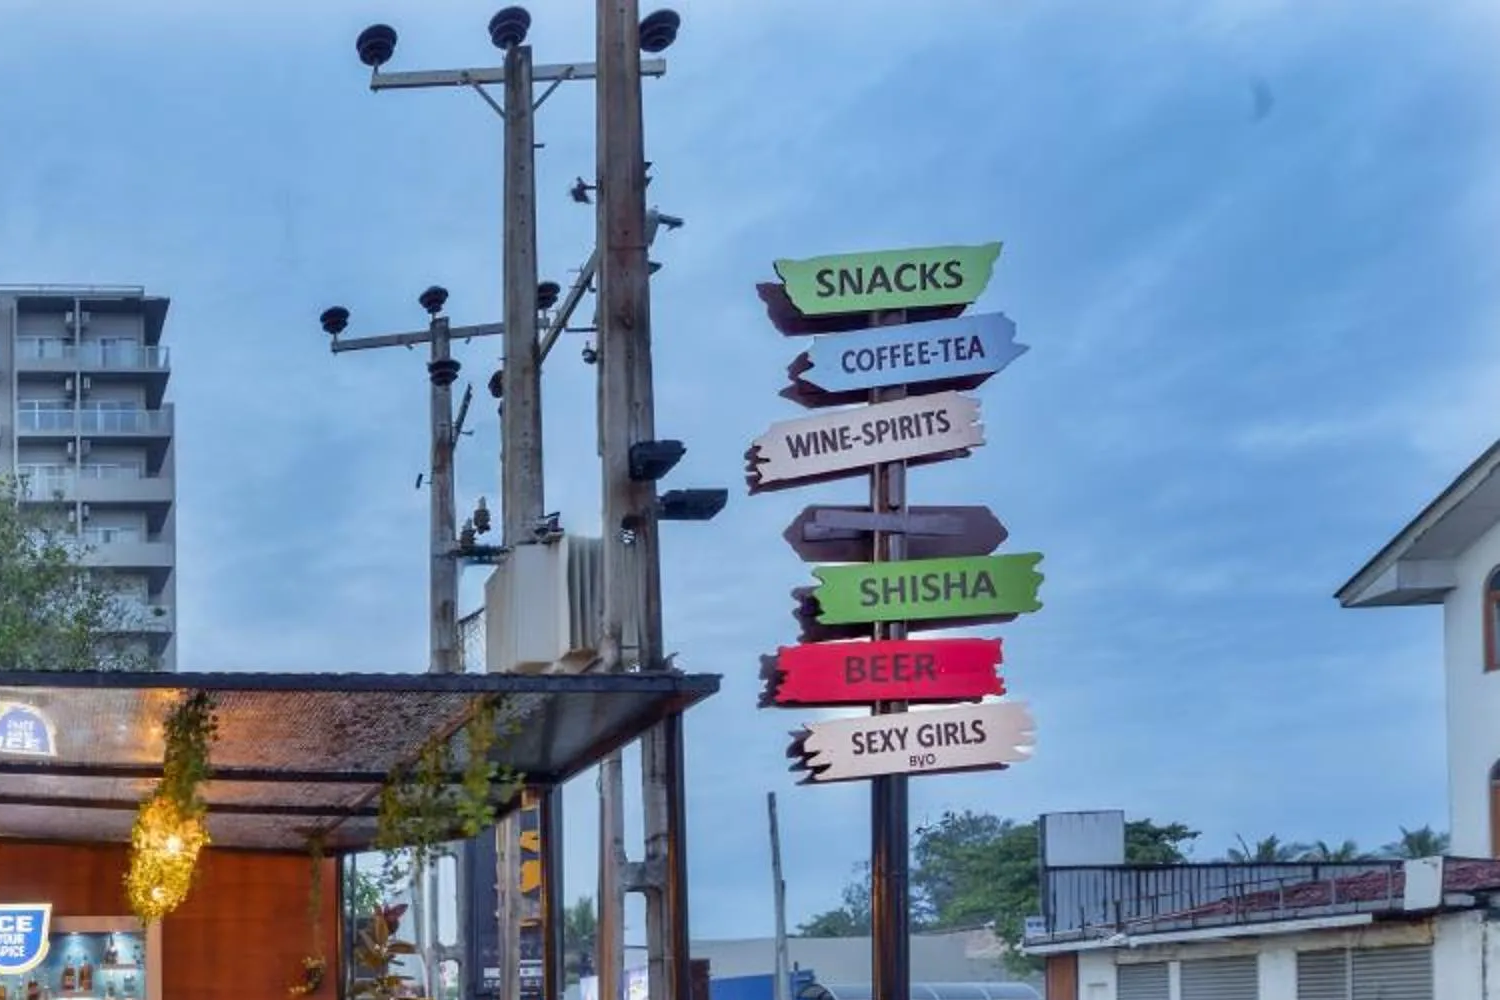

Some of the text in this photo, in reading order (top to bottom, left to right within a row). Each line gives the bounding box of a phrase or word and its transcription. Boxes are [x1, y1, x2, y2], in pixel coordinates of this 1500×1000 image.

[815, 259, 963, 298] SNACKS
[841, 335, 985, 374] COFFEE-TEA
[785, 410, 951, 459] WINE-SPIRITS
[860, 571, 997, 607] SHISHA
[844, 653, 937, 684] BEER
[852, 719, 987, 756] SEXY GIRLS
